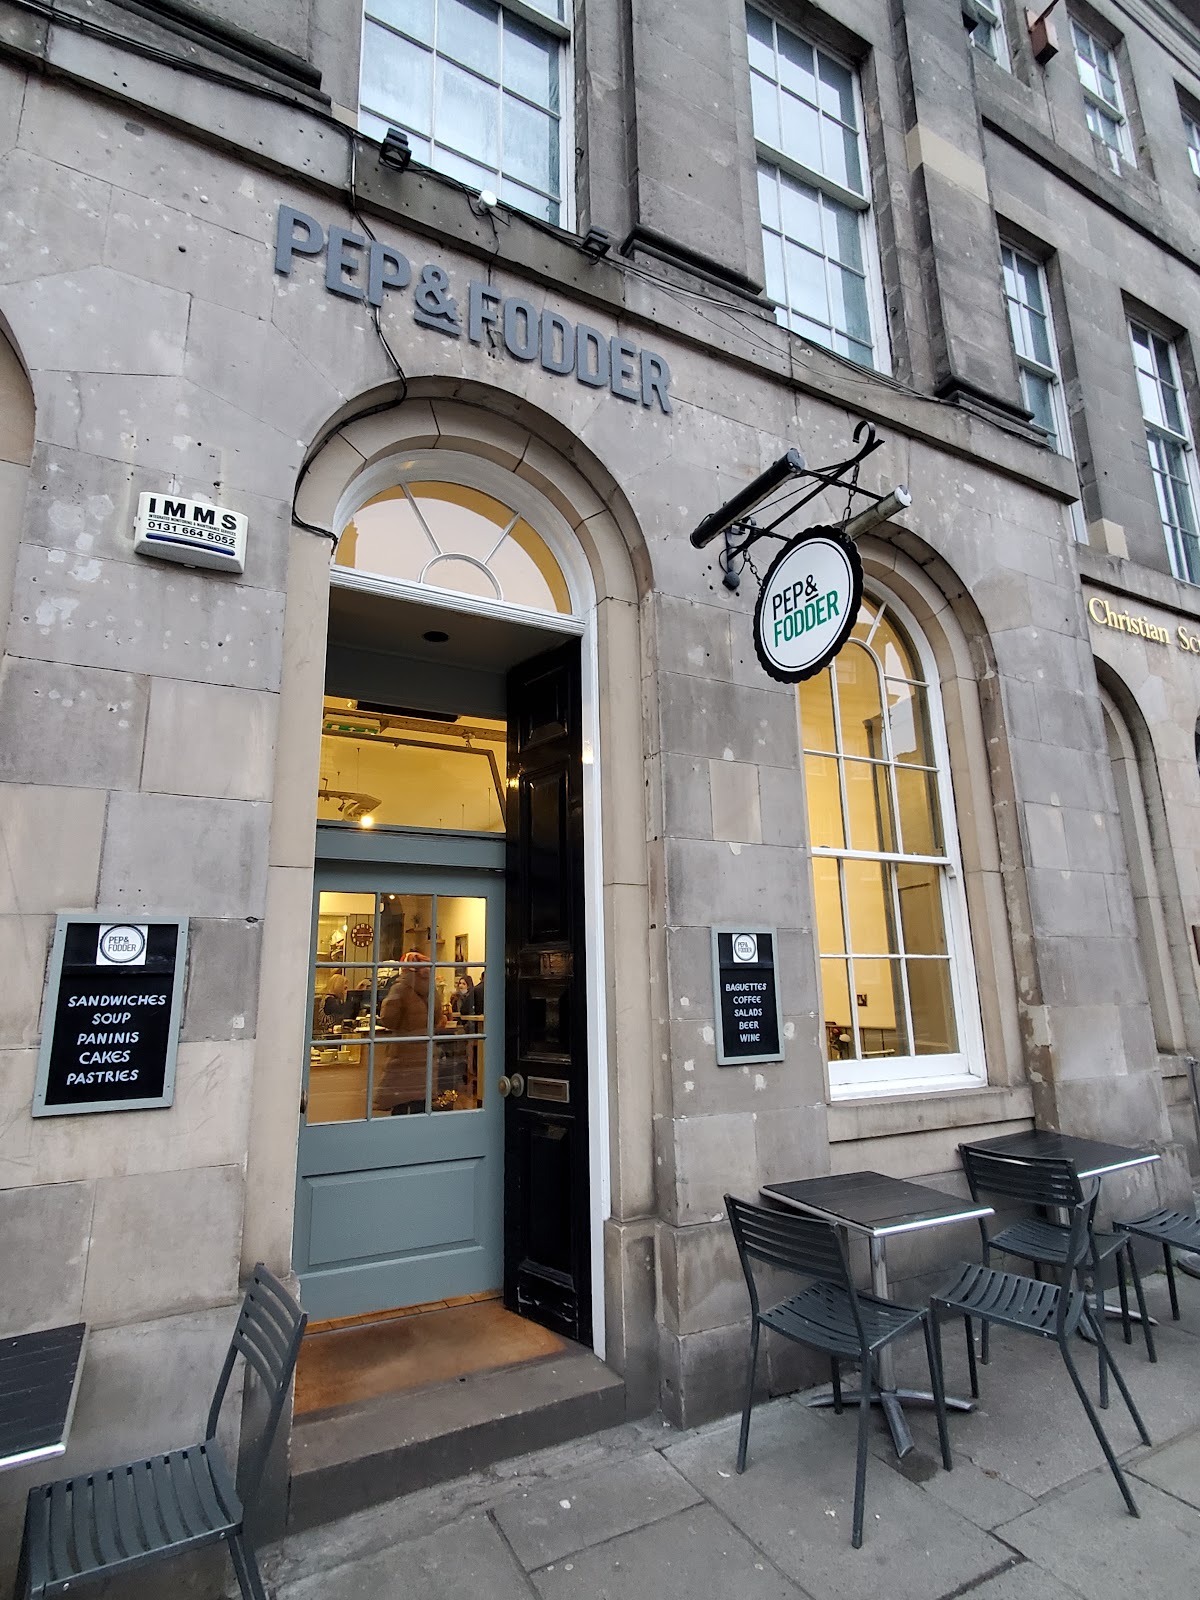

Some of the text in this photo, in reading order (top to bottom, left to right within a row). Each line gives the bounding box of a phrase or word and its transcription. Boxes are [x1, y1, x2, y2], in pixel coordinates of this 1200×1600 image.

[468, 279, 672, 413] FODDER
[149, 498, 237, 530] IMMS
[148, 521, 235, 545] 0131 664 5052
[773, 590, 840, 648] FODDER
[1088, 597, 1172, 645] Christian
[108, 944, 137, 952] FODDER
[725, 983, 767, 992] BAGUETTES
[68, 995, 167, 1008] SANDWICHES
[733, 995, 762, 1005] COFFEE
[91, 1013, 132, 1025] SOUP
[734, 1008, 763, 1018] SALADS
[738, 1020, 760, 1031] BEER
[76, 1031, 140, 1046] PANINIS
[739, 1033, 761, 1043] WINE
[78, 1050, 131, 1065] CAKES
[66, 1069, 140, 1086] PASTRIES
